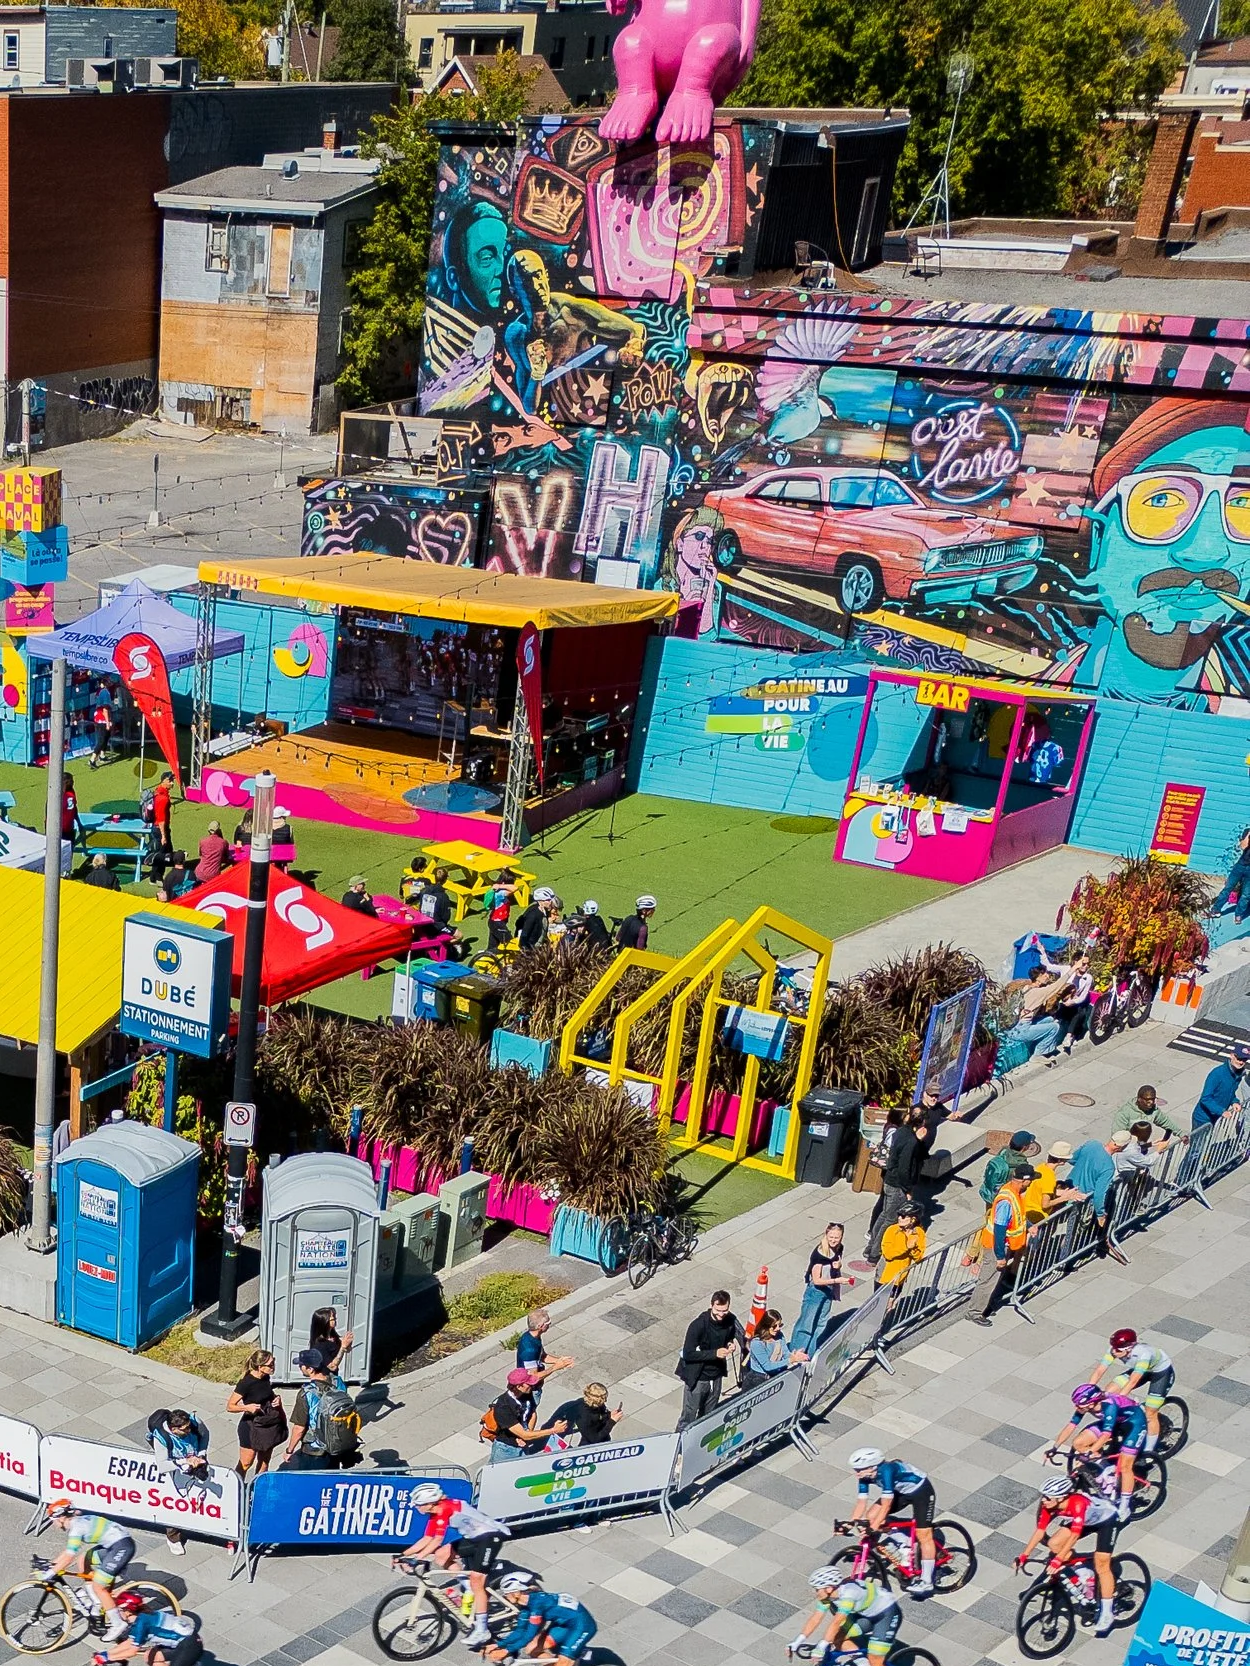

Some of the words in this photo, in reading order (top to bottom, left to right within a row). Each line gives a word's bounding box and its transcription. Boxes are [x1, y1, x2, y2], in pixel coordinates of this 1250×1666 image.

[627, 369, 672, 411] POW
[60, 631, 119, 648] TEMPSLIB
[763, 678, 849, 694] GATINEAU
[763, 698, 811, 713] POUR
[916, 680, 971, 712] BAR
[761, 716, 783, 732] LA
[760, 734, 789, 749] VIE
[141, 977, 196, 1008] DUBÉ
[123, 1003, 210, 1041] STATIONNEMENT
[150, 1028, 180, 1045] PARKING
[575, 1444, 643, 1466] GATINEAU
[107, 1456, 167, 1484] ESPACE
[554, 1464, 592, 1481] POUR
[49, 1469, 142, 1505] Banque
[147, 1488, 222, 1519] Scotia
[552, 1480, 568, 1491] LA
[321, 1488, 333, 1500] LE
[335, 1483, 392, 1513] TOUR
[397, 1489, 409, 1501] DE
[550, 1490, 571, 1502] VIE
[298, 1507, 413, 1536] GATINEAU
[1158, 1623, 1250, 1653] PROFIT
[1177, 1648, 1194, 1658] DE
